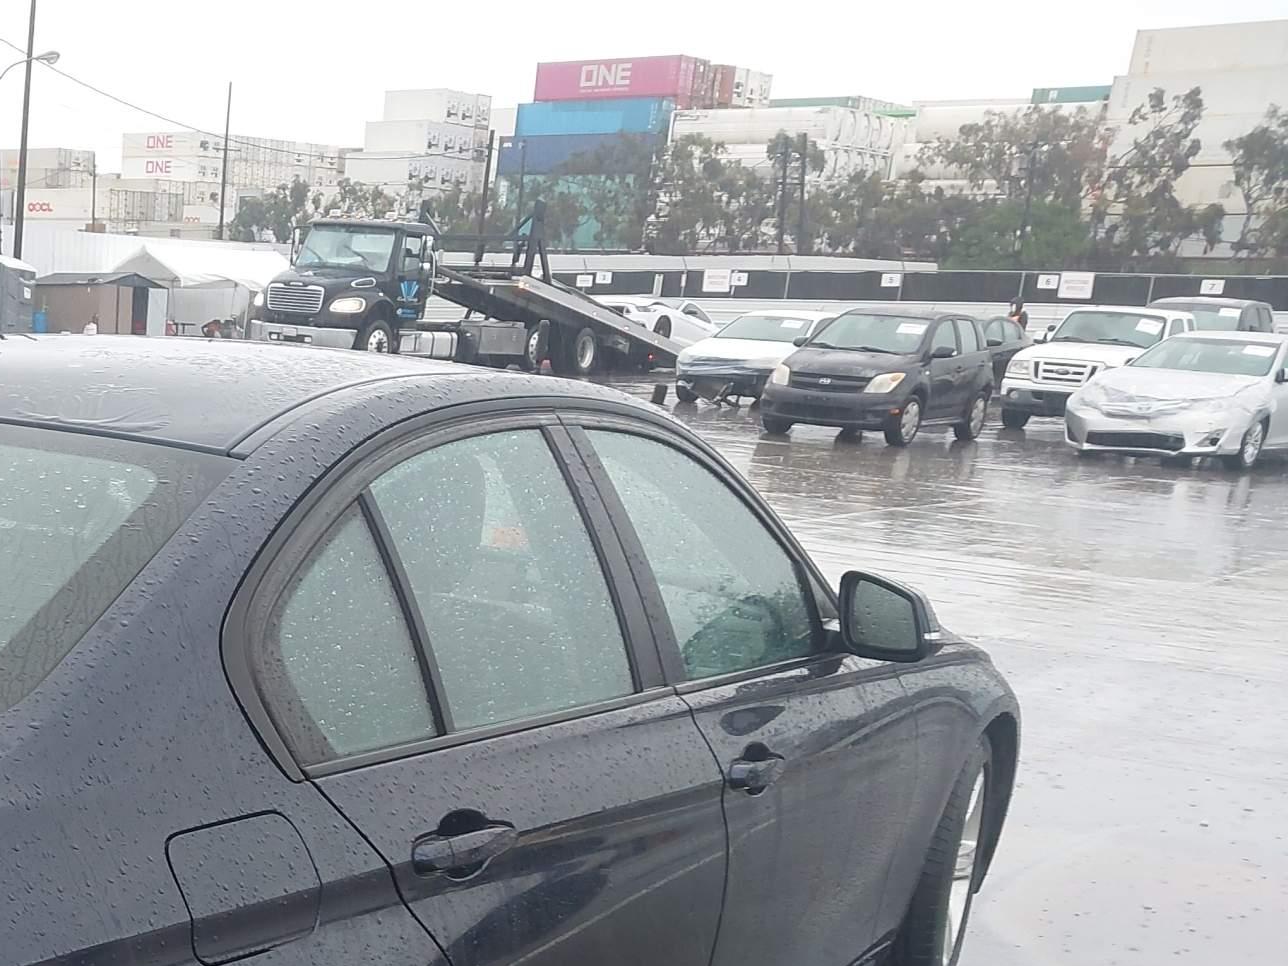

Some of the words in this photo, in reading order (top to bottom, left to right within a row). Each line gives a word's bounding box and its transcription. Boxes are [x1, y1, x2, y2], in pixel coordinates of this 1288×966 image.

[580, 63, 632, 87] ONE
[146, 135, 173, 149] ONE
[145, 160, 172, 174] ONE
[27, 202, 53, 212] OOCL
